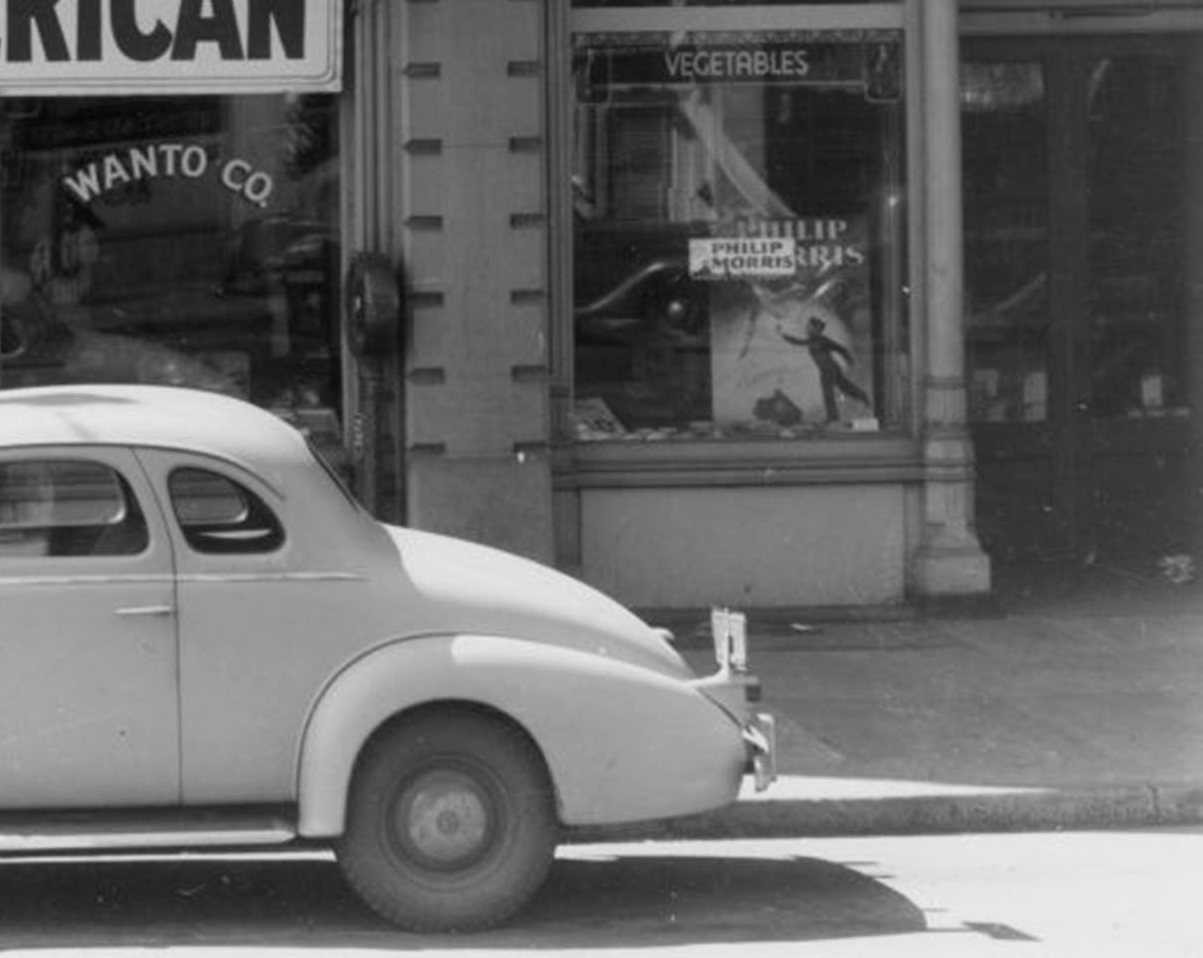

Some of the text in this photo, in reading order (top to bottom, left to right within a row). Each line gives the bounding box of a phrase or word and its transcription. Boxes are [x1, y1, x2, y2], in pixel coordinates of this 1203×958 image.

[665, 50, 809, 76] VEGETABLES
[64, 145, 274, 208] WANTO CO.
[711, 241, 783, 255] PHILIP
[711, 255, 794, 270] MORRIS
